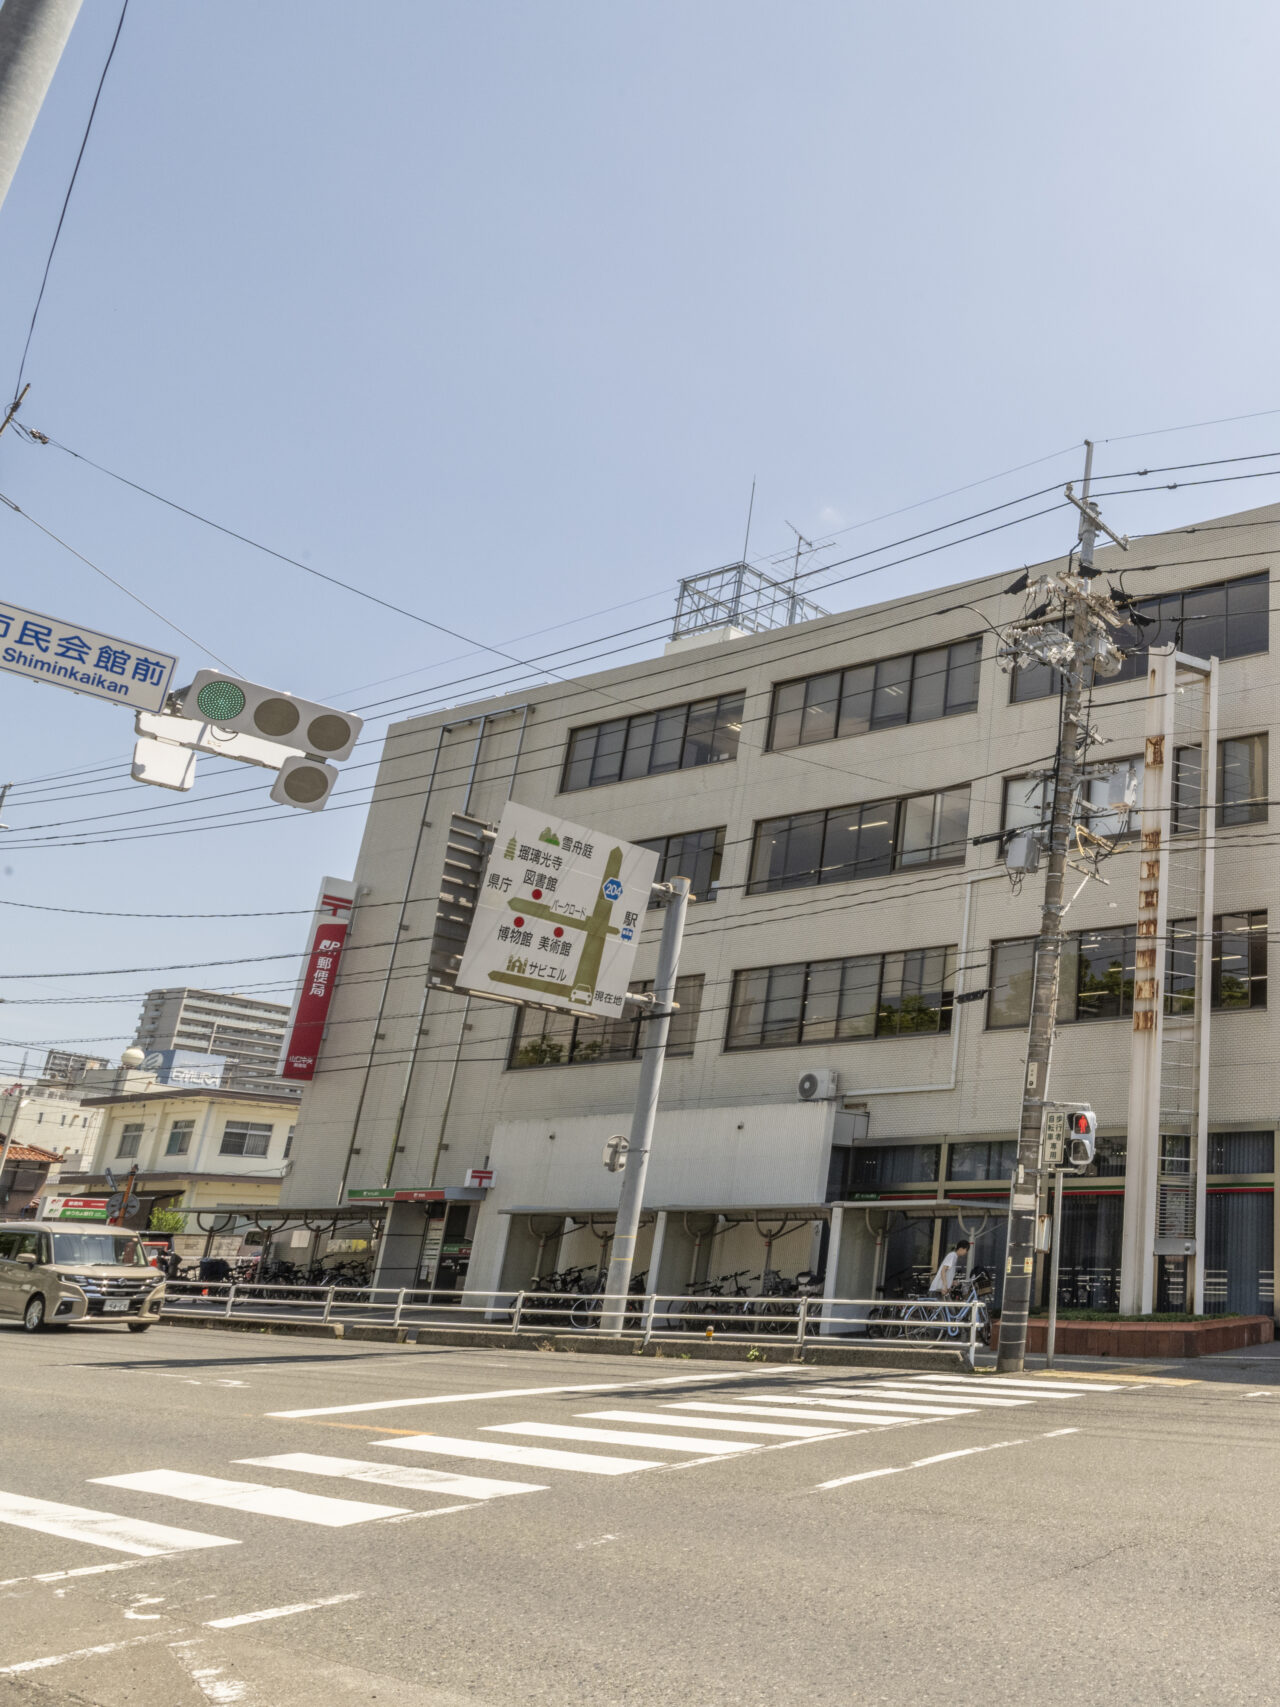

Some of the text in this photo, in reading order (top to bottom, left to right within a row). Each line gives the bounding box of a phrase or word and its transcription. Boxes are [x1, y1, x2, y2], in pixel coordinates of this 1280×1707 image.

[2, 647, 130, 697] Shiminkaikan
[517, 844, 563, 871] 瑠璃光寺
[561, 836, 595, 859] 雪舟庭
[487, 873, 513, 893] 県庁
[523, 869, 558, 892] 図書館
[604, 882, 622, 896] 204
[550, 899, 587, 918] パークロード
[623, 911, 639, 928] 駅
[497, 925, 534, 948] 博物館
[537, 935, 573, 957] 美術館
[309, 956, 333, 997] 郵便局
[529, 961, 567, 982] サビエル
[594, 990, 622, 1006] 現在地
